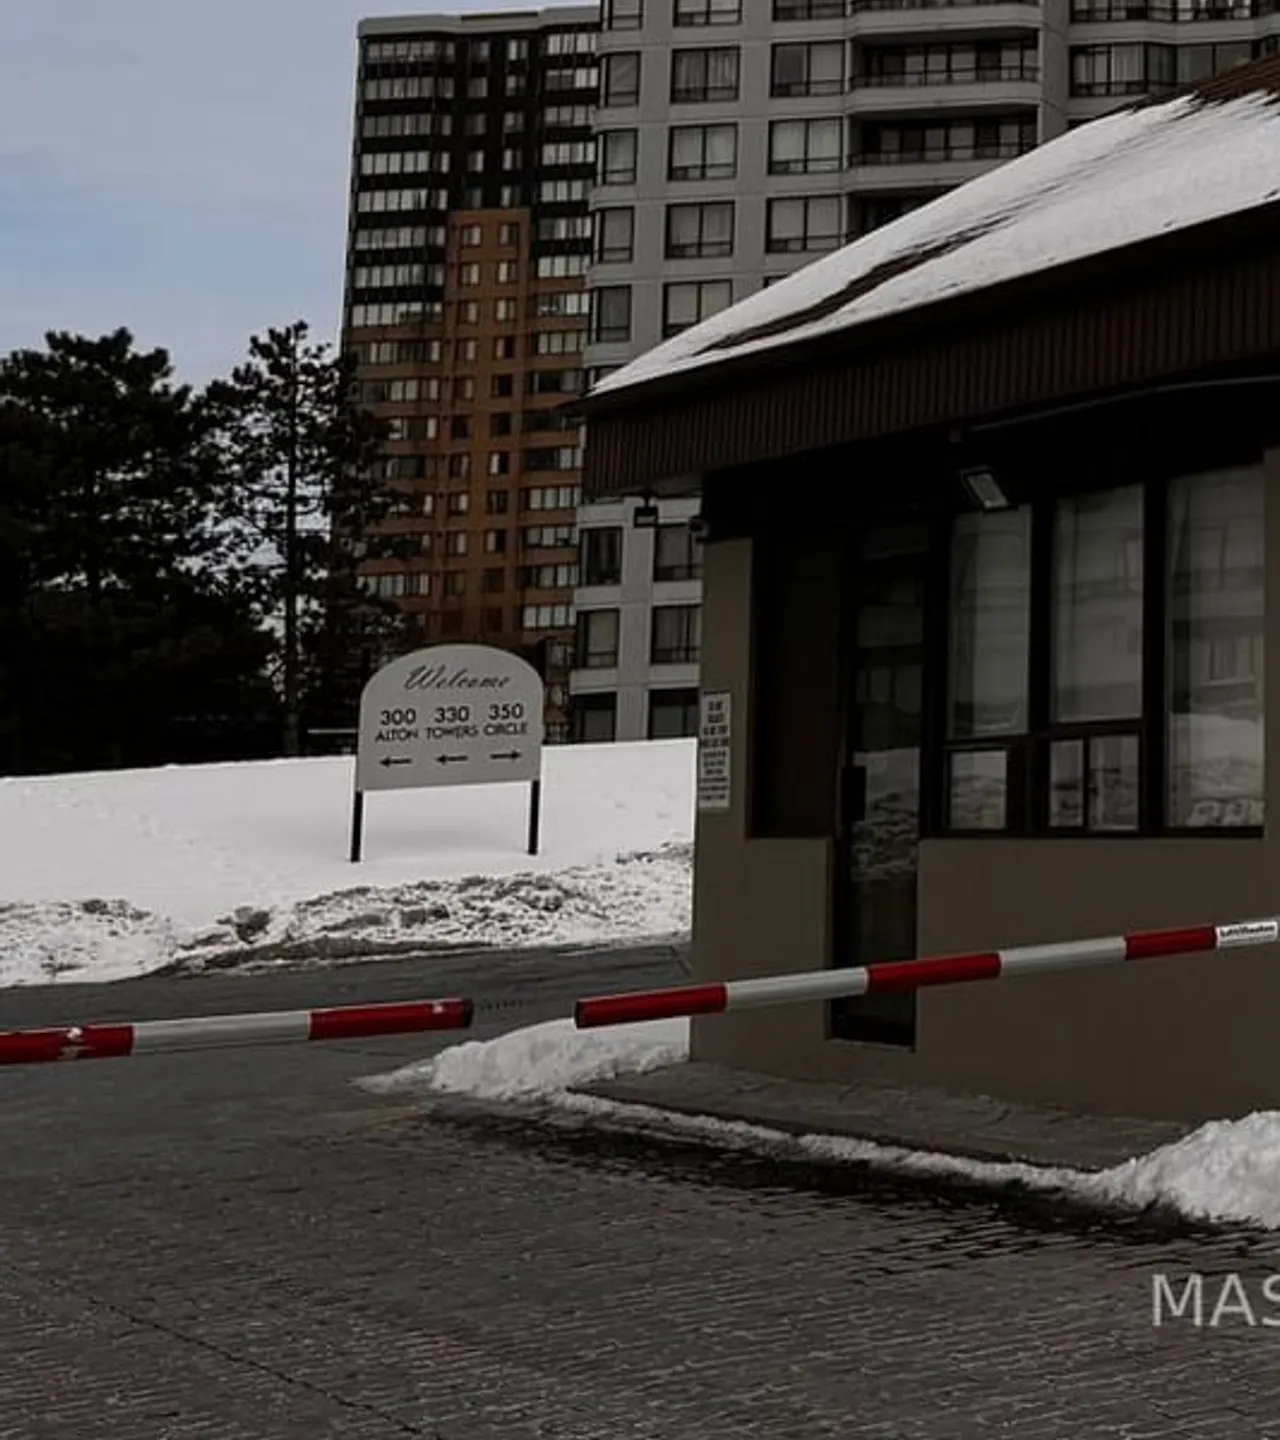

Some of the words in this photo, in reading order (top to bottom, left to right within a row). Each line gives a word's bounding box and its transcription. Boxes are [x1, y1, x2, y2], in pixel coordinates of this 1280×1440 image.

[404, 664, 511, 690] Welcome
[380, 708, 417, 726] 300
[434, 705, 470, 723] 330
[488, 703, 524, 721] 350
[375, 728, 419, 742] ALTON
